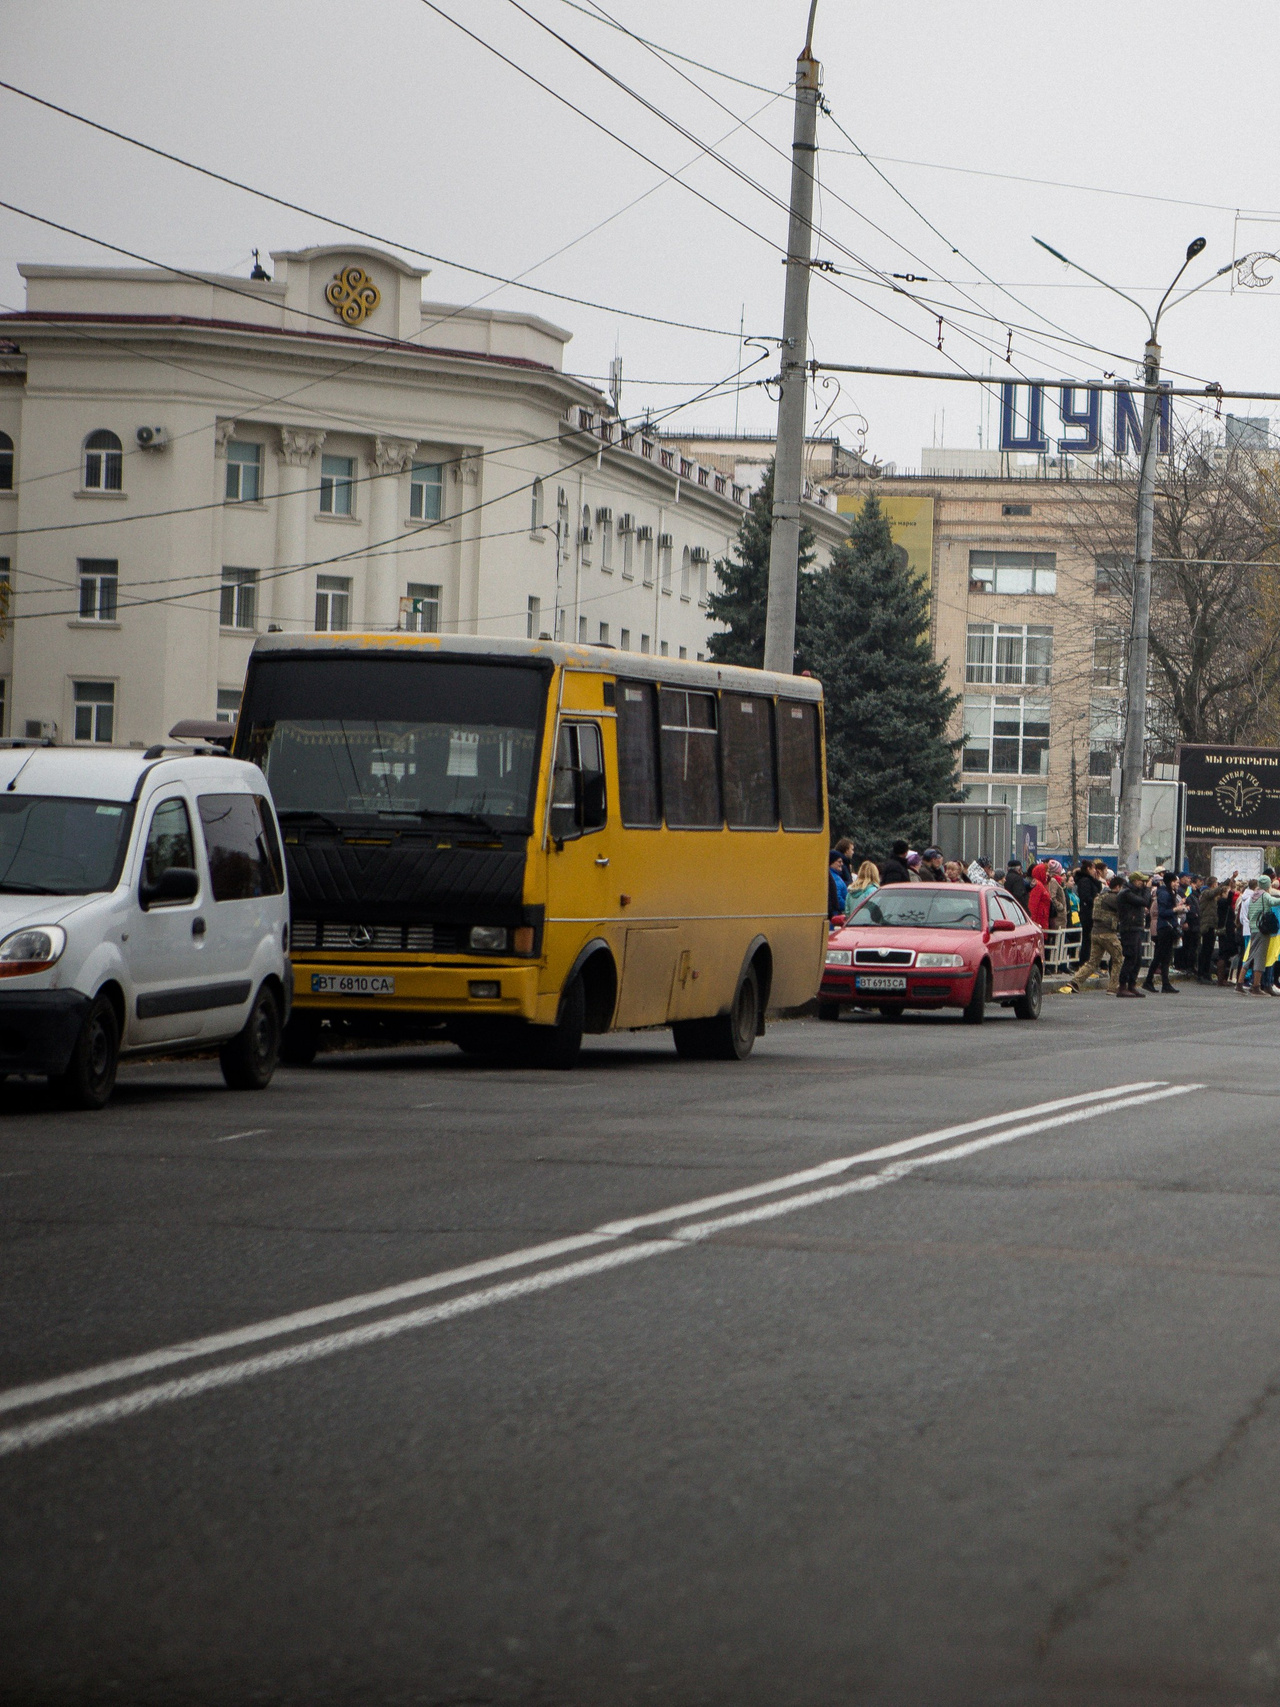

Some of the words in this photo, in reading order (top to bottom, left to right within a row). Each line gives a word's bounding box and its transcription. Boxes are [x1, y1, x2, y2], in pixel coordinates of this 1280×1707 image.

[999, 377, 1173, 455] ЦУМ
[1205, 755, 1222, 764] МЫ
[1225, 756, 1278, 766] ОТКРЫТЫ
[1186, 825, 1225, 836] Попробуй
[1227, 827, 1258, 836] эмоции
[340, 977, 368, 990] 6810
